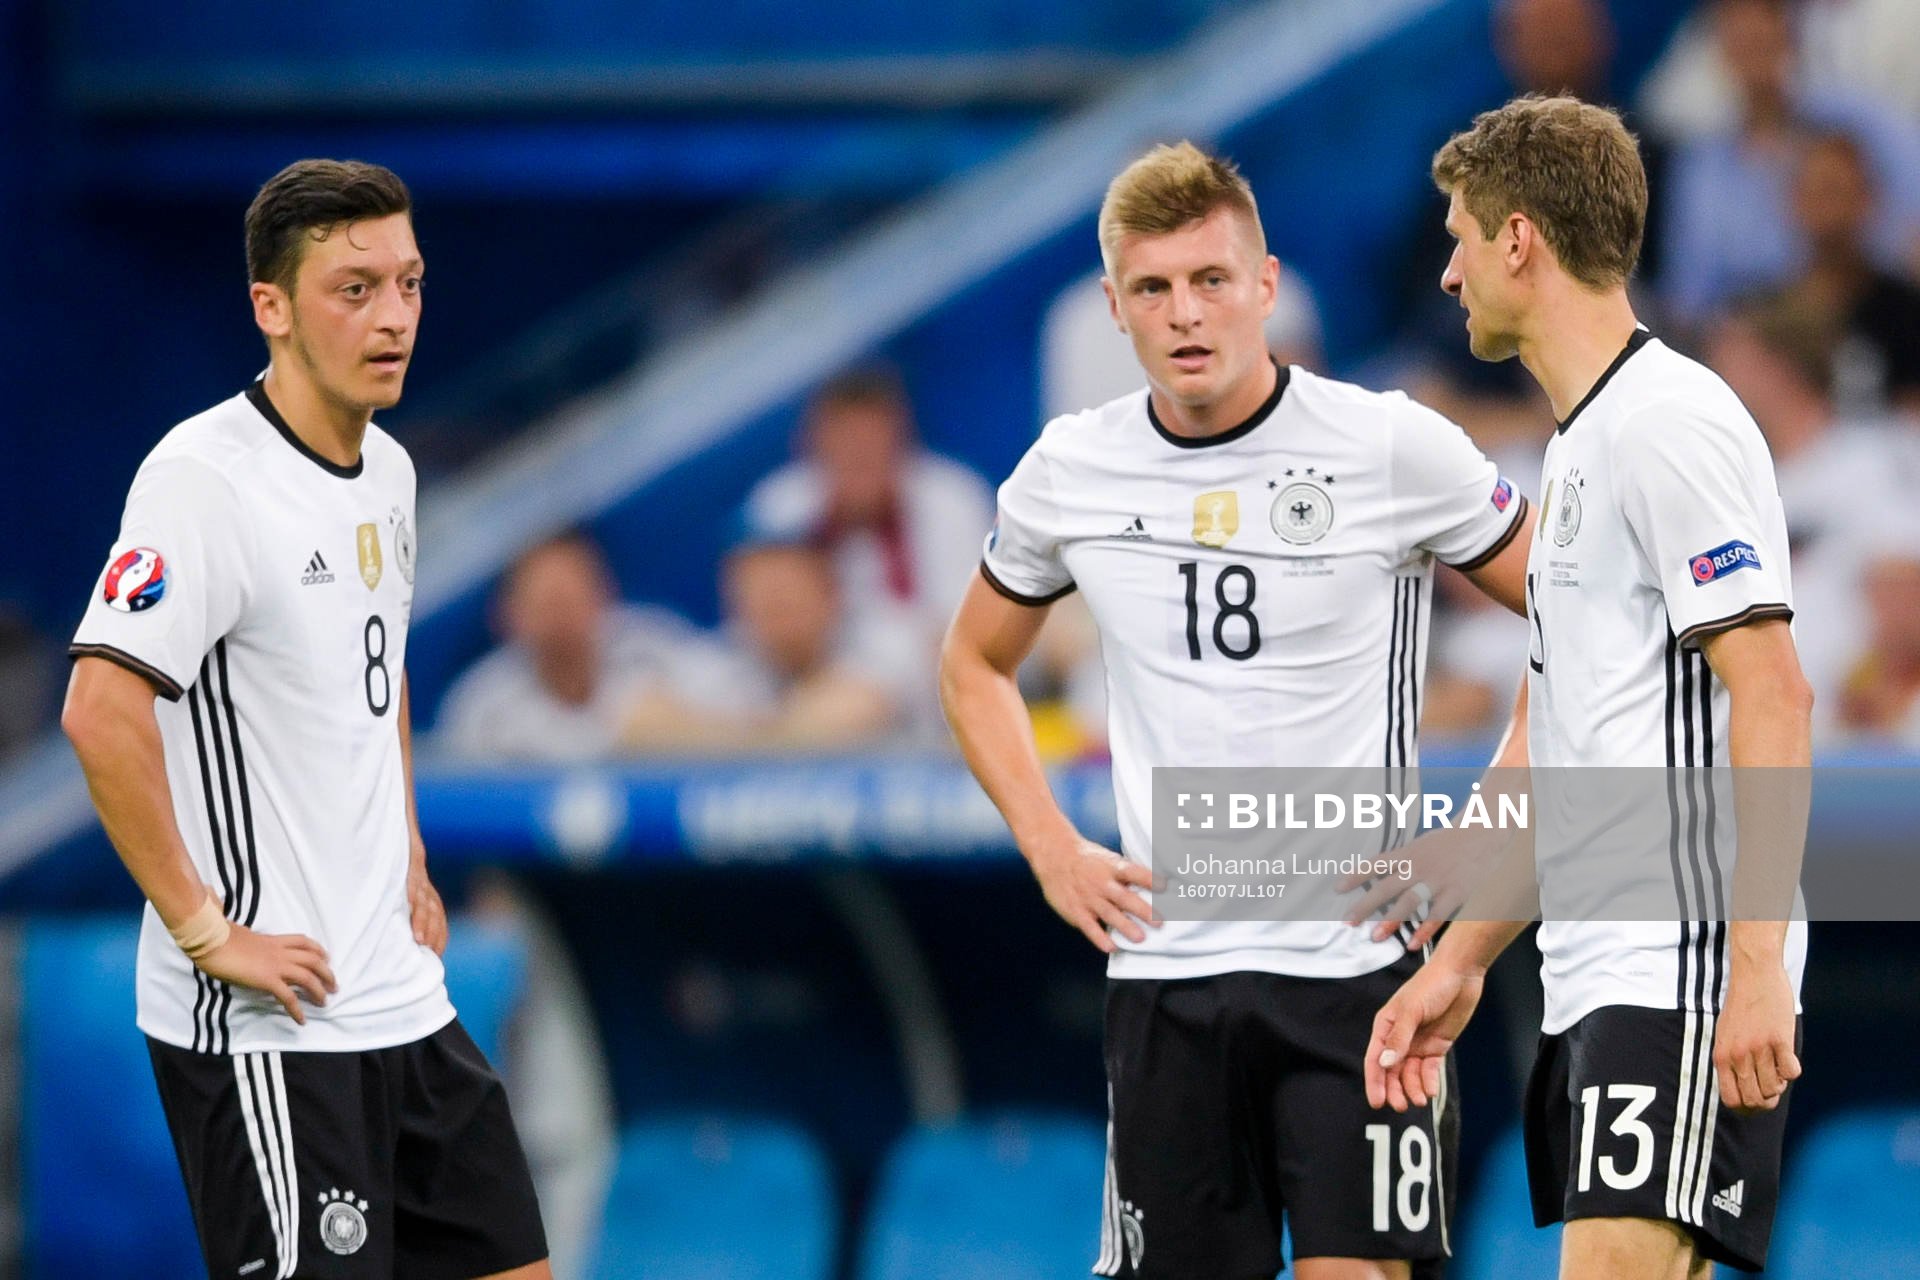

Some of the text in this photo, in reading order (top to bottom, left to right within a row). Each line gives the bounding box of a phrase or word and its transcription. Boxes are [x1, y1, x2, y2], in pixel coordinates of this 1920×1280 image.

[1178, 562, 1261, 661] 18
[364, 614, 391, 717] 8
[1365, 1124, 1432, 1232] 18
[1578, 1083, 1657, 1192] 13
